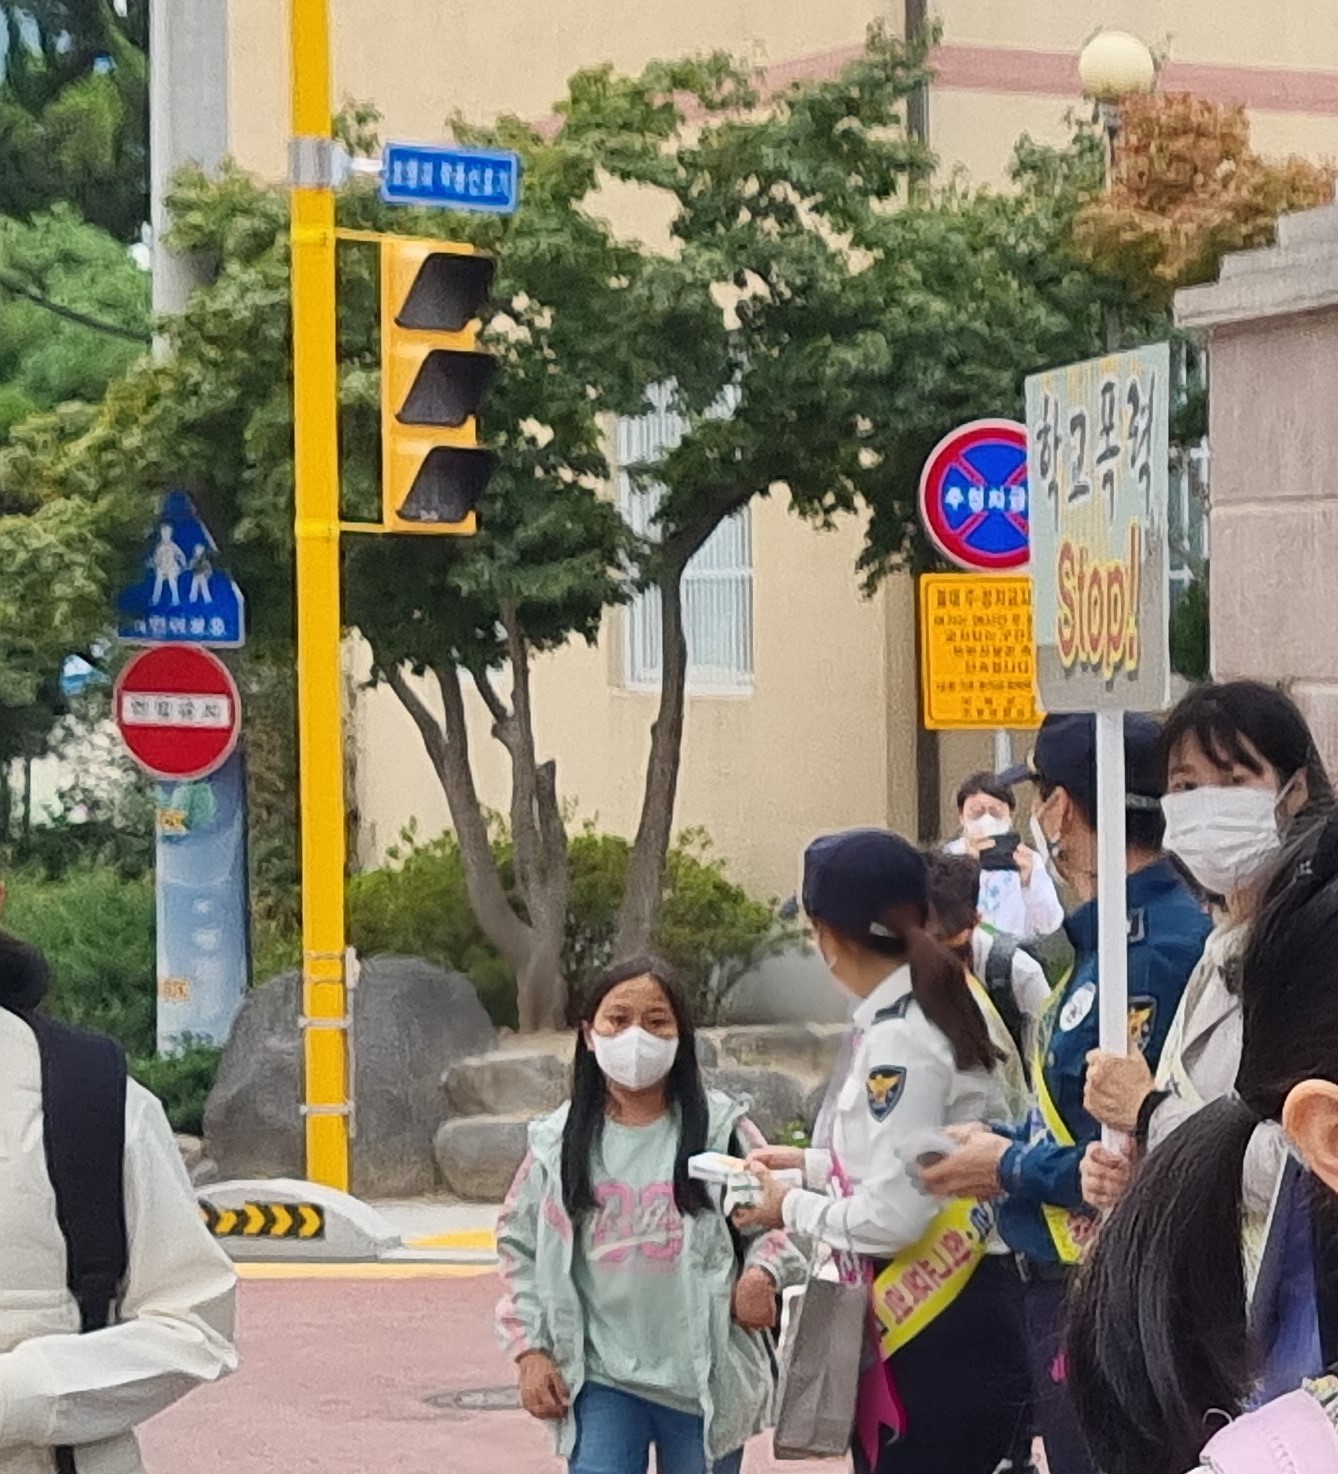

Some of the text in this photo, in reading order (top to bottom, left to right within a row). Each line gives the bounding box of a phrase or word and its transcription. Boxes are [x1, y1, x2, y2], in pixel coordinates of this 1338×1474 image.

[943, 485, 1027, 514] 주정차금
[1036, 367, 1156, 532] 학교폭력
[1057, 516, 1141, 682] Stop!
